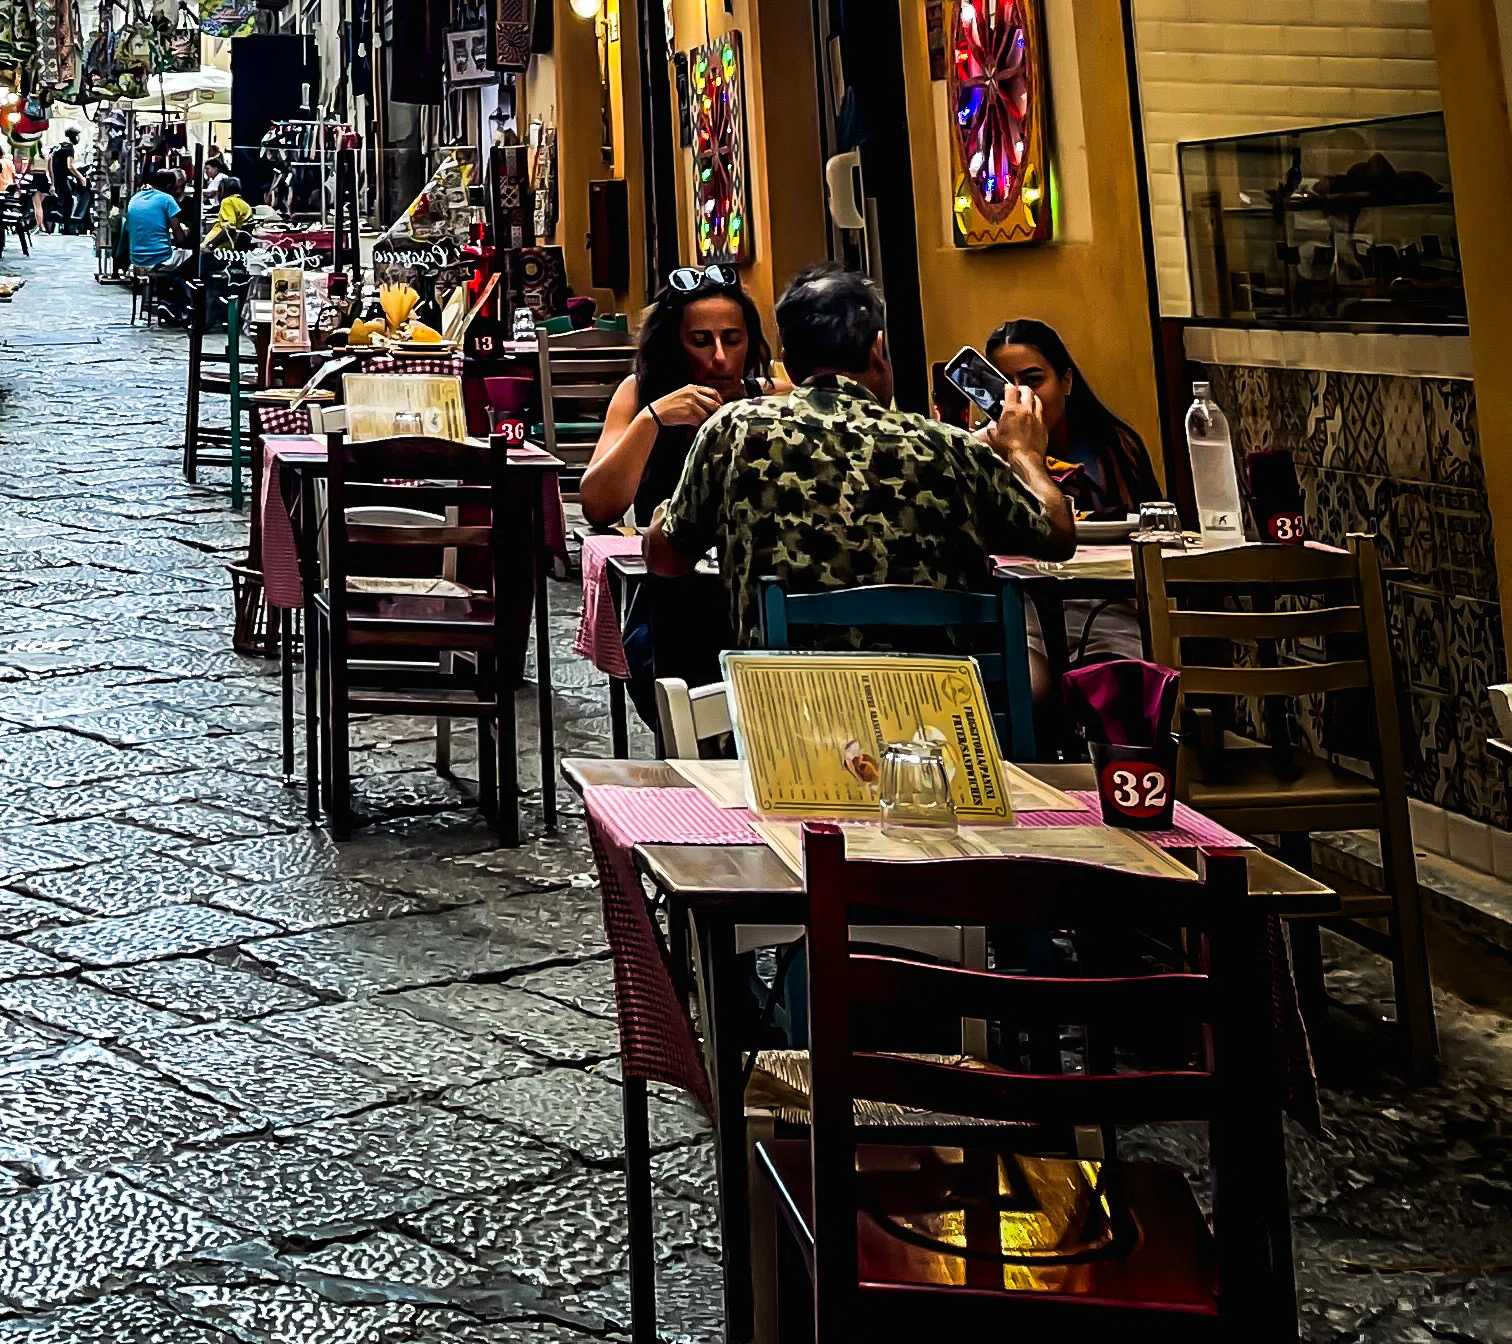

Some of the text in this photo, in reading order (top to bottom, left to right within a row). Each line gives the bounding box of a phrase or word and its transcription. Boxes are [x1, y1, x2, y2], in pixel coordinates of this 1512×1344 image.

[474, 336, 493, 351] 13
[501, 422, 524, 441] 36
[1276, 515, 1305, 540] 33
[1112, 770, 1167, 807] 32
